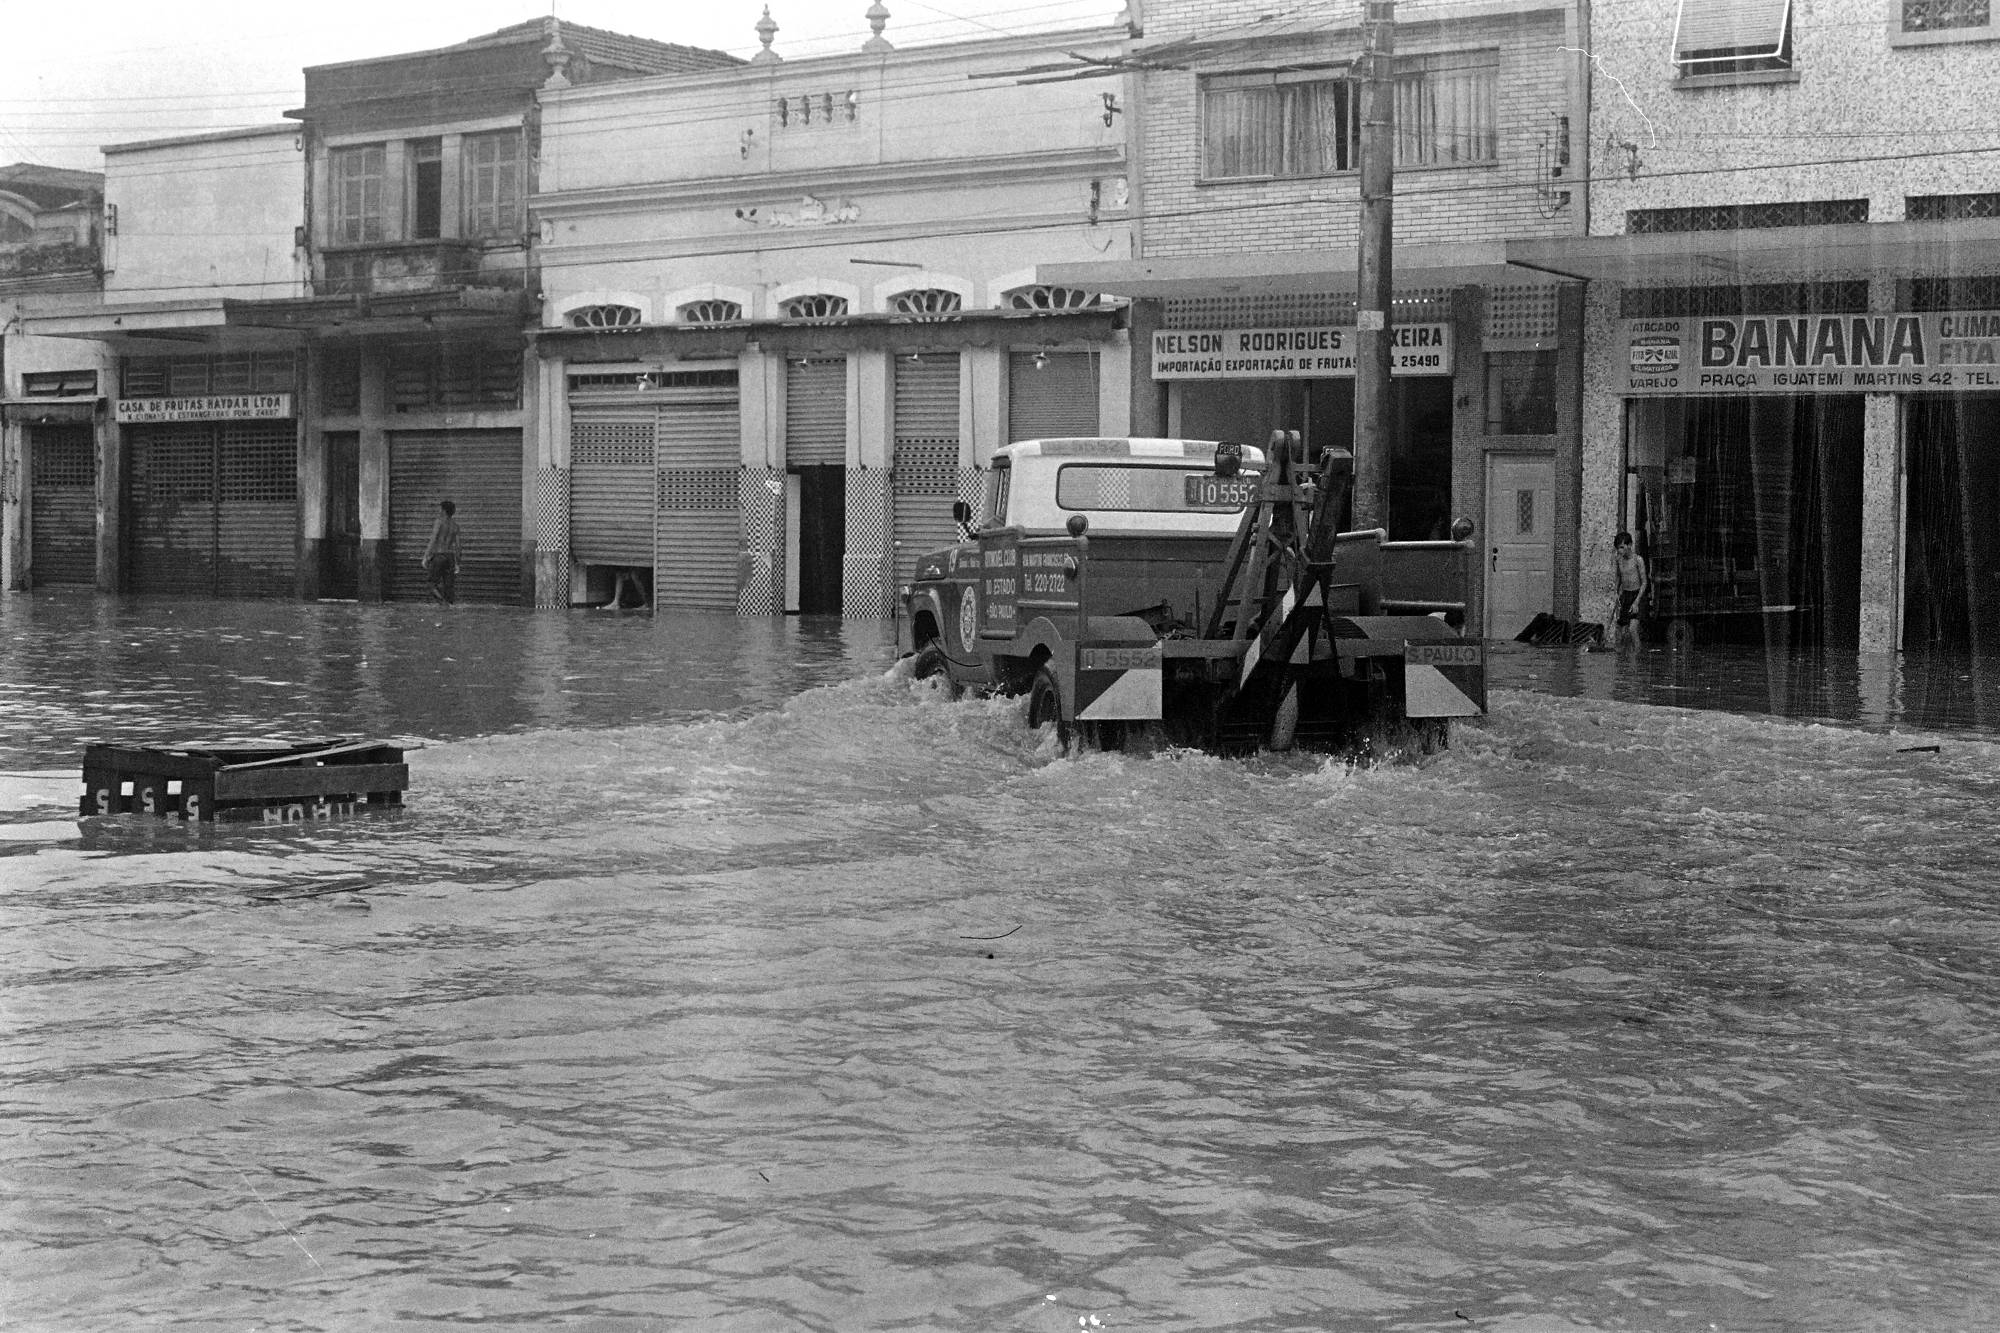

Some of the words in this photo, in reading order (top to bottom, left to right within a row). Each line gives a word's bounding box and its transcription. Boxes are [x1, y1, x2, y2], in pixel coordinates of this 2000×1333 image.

[1632, 321, 1680, 333] ATACADO
[1156, 334, 1222, 354] NELSON
[1239, 331, 1342, 352] RODRIGUES
[1391, 327, 1443, 347] XEIRA
[1700, 315, 1927, 368] BANANA
[1938, 341, 1997, 364] FITA
[1157, 357, 1222, 373] IMPORTAÇÃO
[1225, 355, 1294, 372] EXPORTAÇÃO
[1299, 358, 1313, 370] DE
[1400, 354, 1440, 367] 25490
[1629, 377, 1678, 389] VAREJO
[1700, 373, 1757, 388] PRAÇA
[1773, 373, 1843, 387] IGUATEMI
[1853, 372, 1923, 386] MARTINS
[1965, 371, 2000, 386] TEL.
[119, 401, 145, 413] CASA
[150, 400, 162, 411] DE
[164, 399, 203, 411] FRUTAS
[1219, 444, 1240, 454] FORD
[993, 578, 1016, 594] ESTADO
